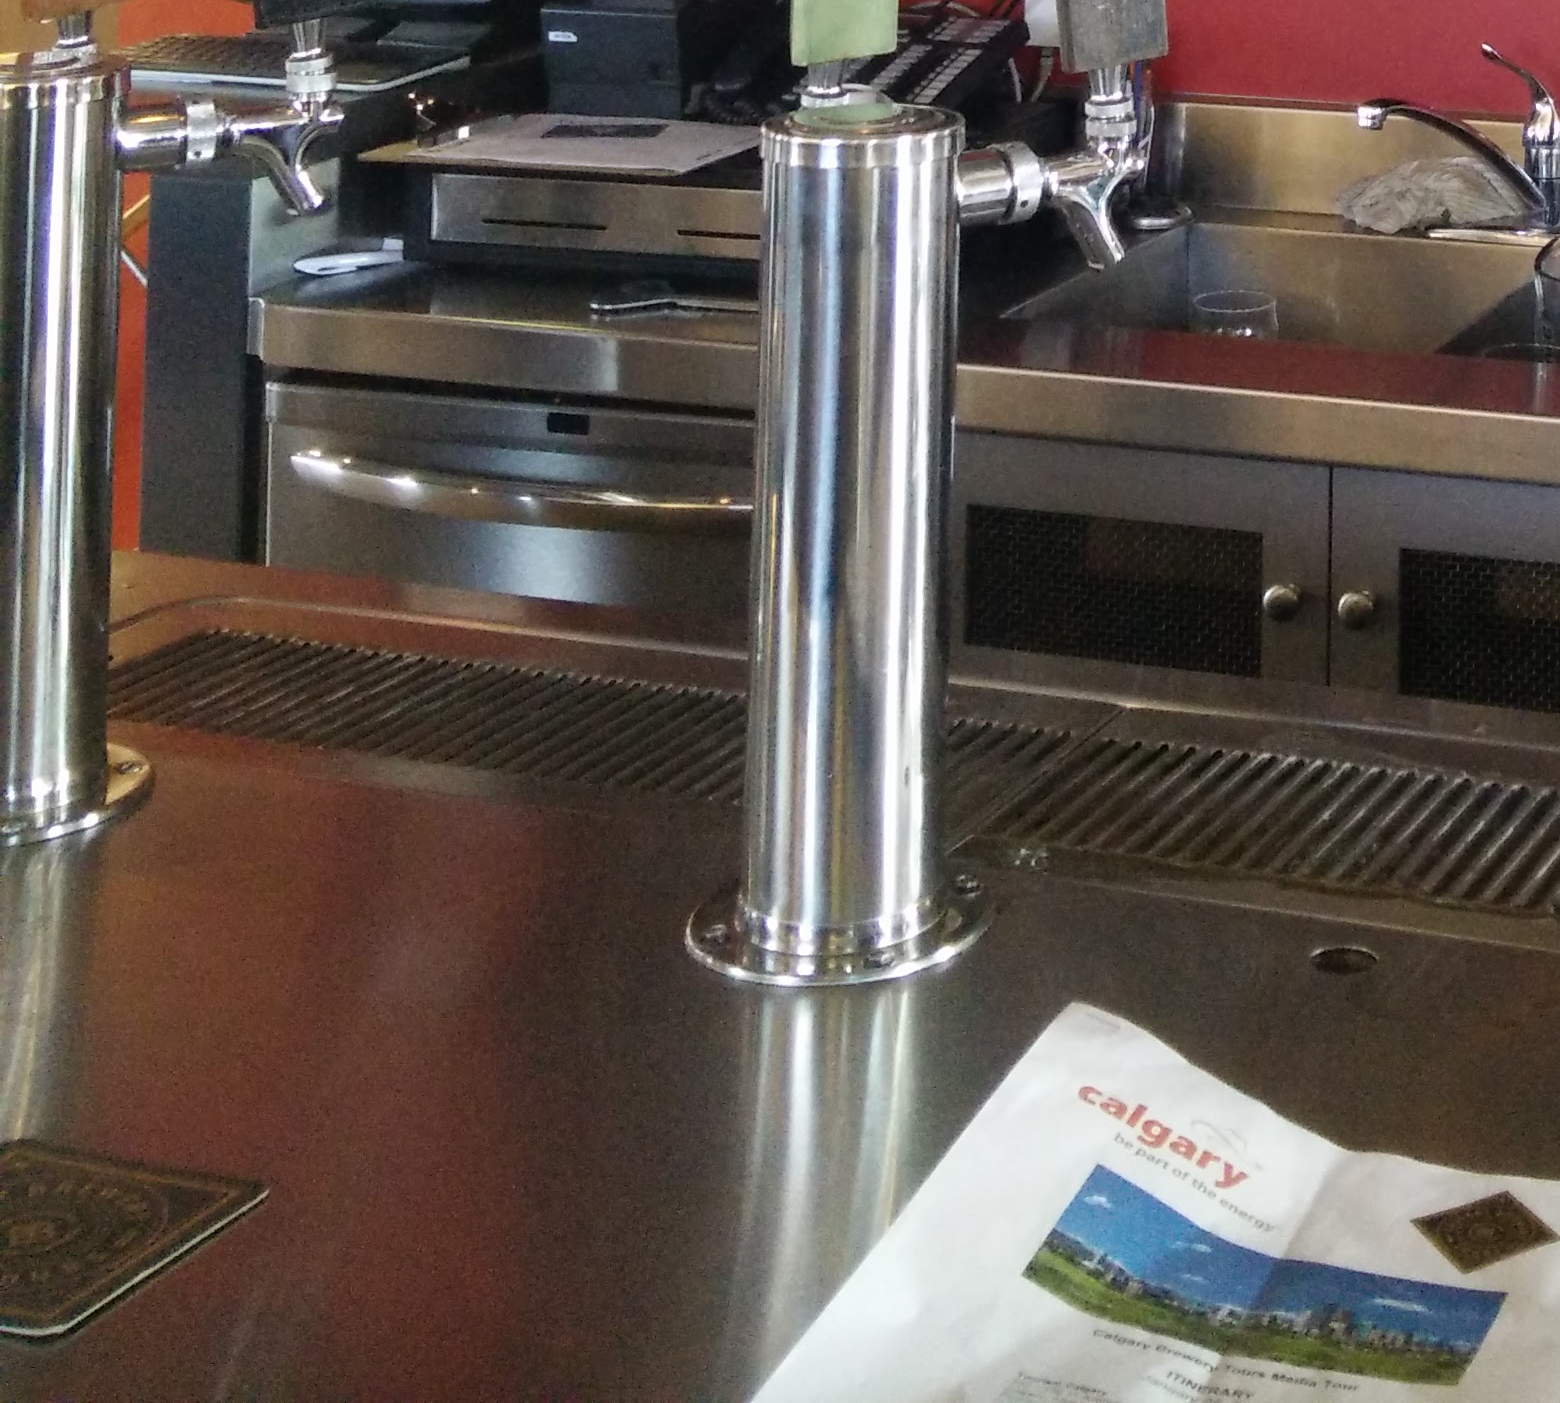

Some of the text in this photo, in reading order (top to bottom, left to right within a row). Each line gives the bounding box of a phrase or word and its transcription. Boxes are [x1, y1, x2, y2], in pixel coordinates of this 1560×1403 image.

[1078, 1085, 1249, 1189] calgary
[1114, 1132, 1277, 1234] be part of the energy
[1094, 1330, 1151, 1351] Calgary
[1225, 1365, 1266, 1379] Tours
[1271, 1372, 1317, 1388] Media
[1324, 1379, 1360, 1392] Tour
[1166, 1371, 1254, 1399] ITINERARY
